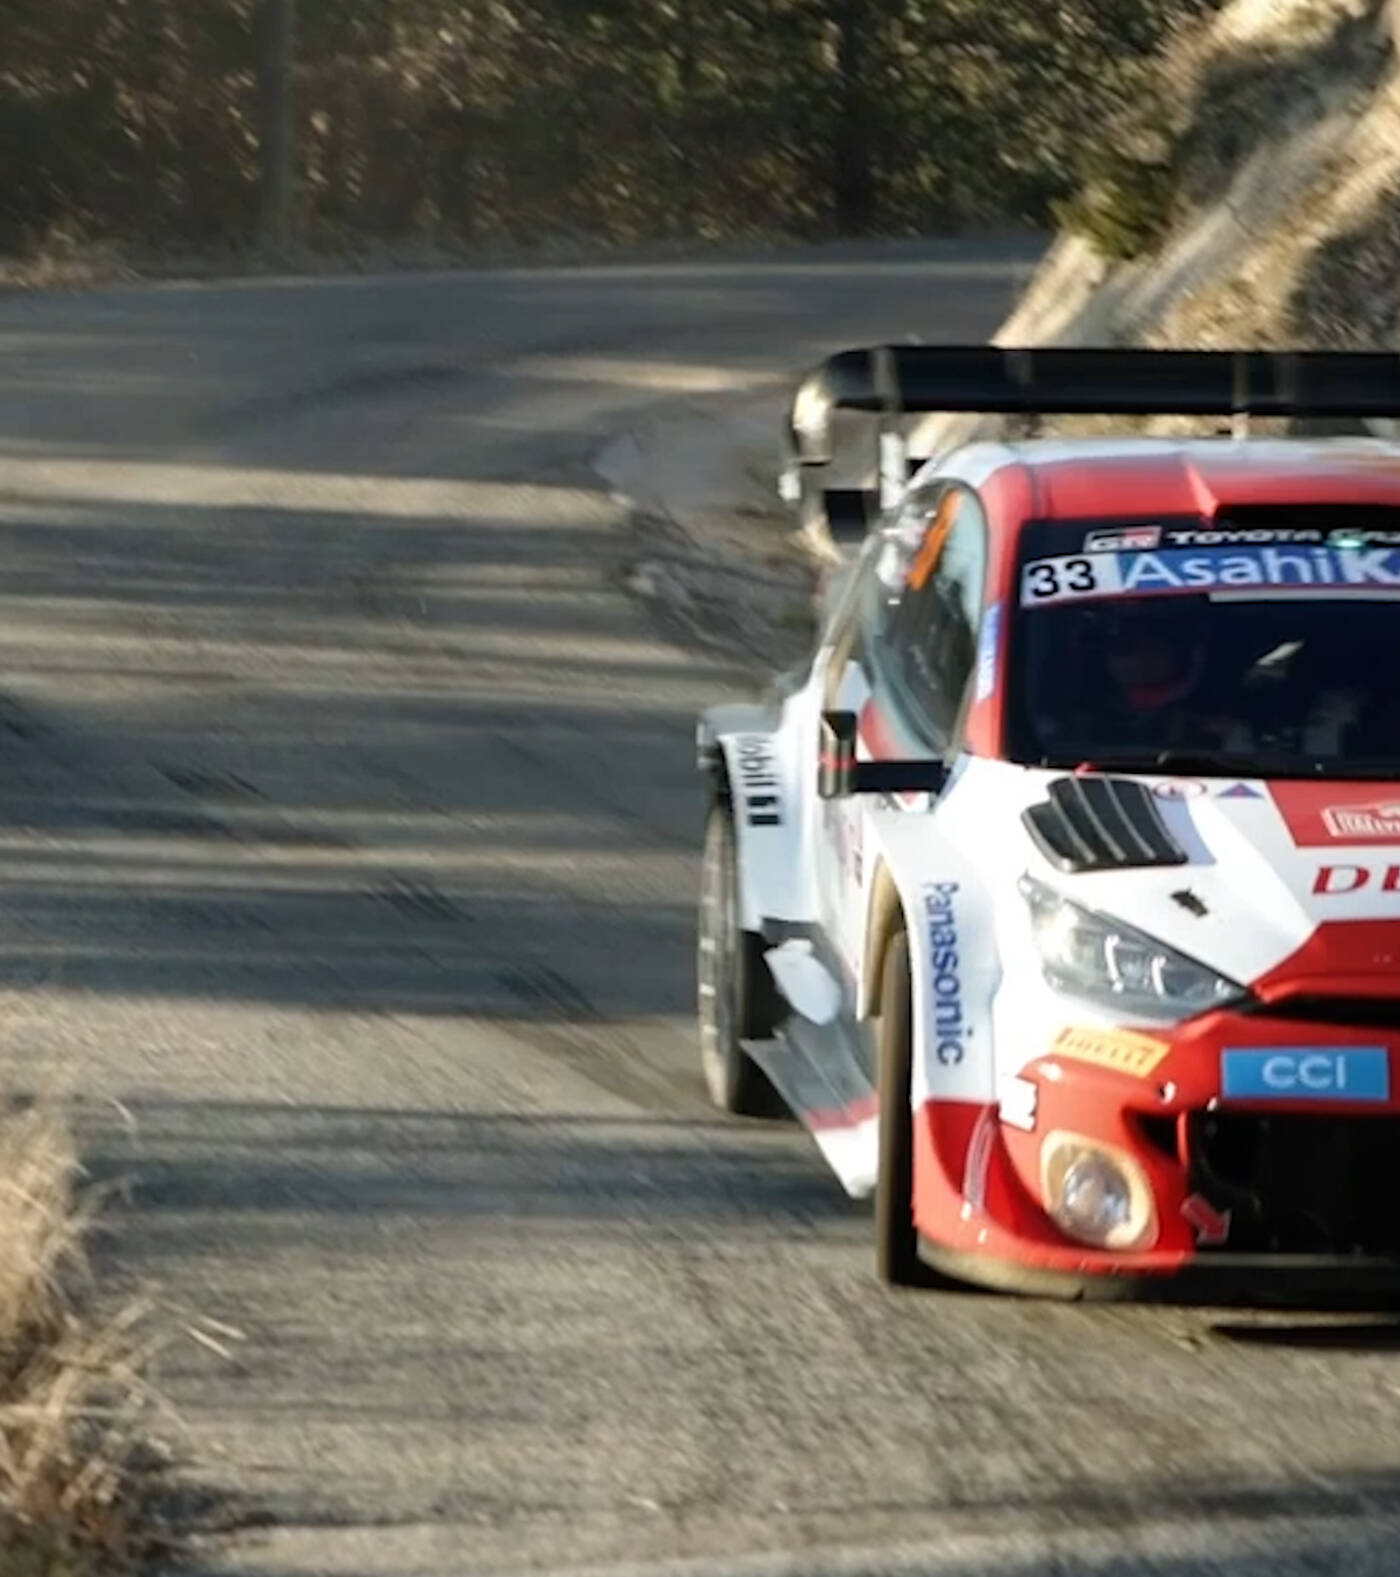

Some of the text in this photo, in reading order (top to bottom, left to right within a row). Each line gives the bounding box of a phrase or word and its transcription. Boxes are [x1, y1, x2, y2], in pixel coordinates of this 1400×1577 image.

[1166, 529, 1323, 546] TOYOTA
[1028, 559, 1096, 598] 33
[923, 880, 975, 1067] Panasonic
[1261, 1055, 1347, 1091] CCI
